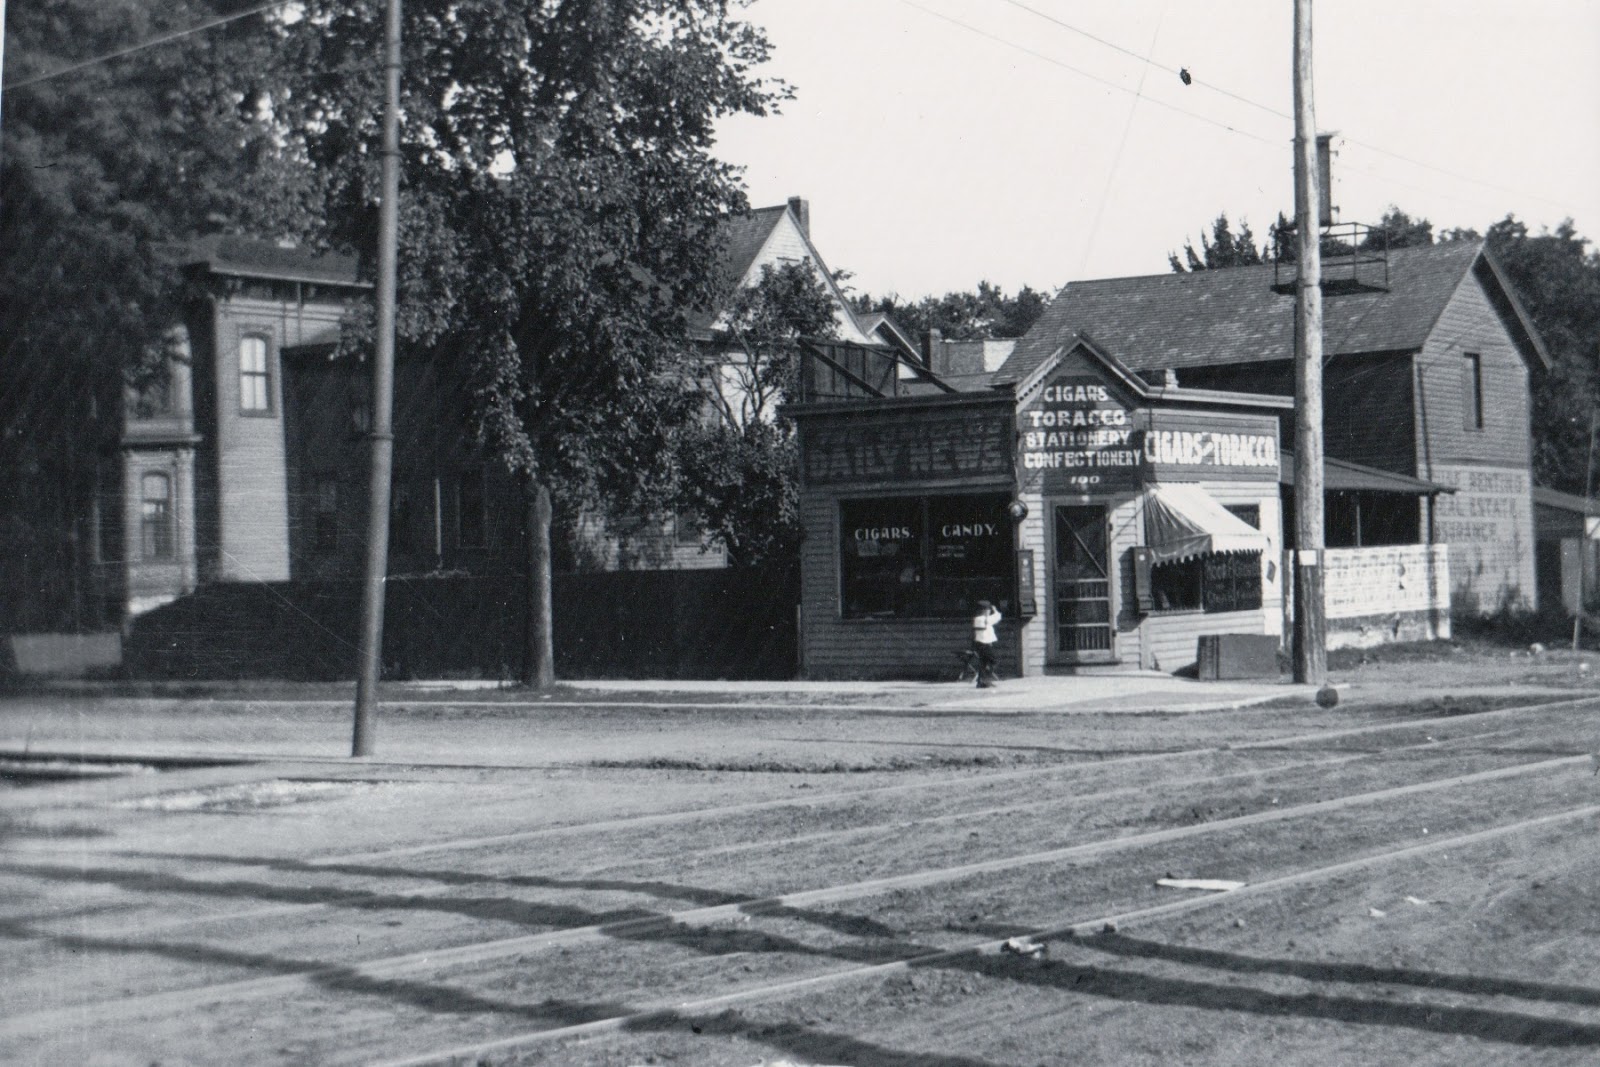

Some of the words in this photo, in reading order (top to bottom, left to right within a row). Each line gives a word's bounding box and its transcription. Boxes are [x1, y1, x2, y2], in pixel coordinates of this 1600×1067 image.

[1044, 385, 1109, 402] CIGARS
[1030, 409, 1126, 428] TOBACCO
[1025, 430, 1131, 448] STATIONERY
[1144, 430, 1203, 465] CIGARS
[1024, 449, 1142, 469] CONFECTIONERY
